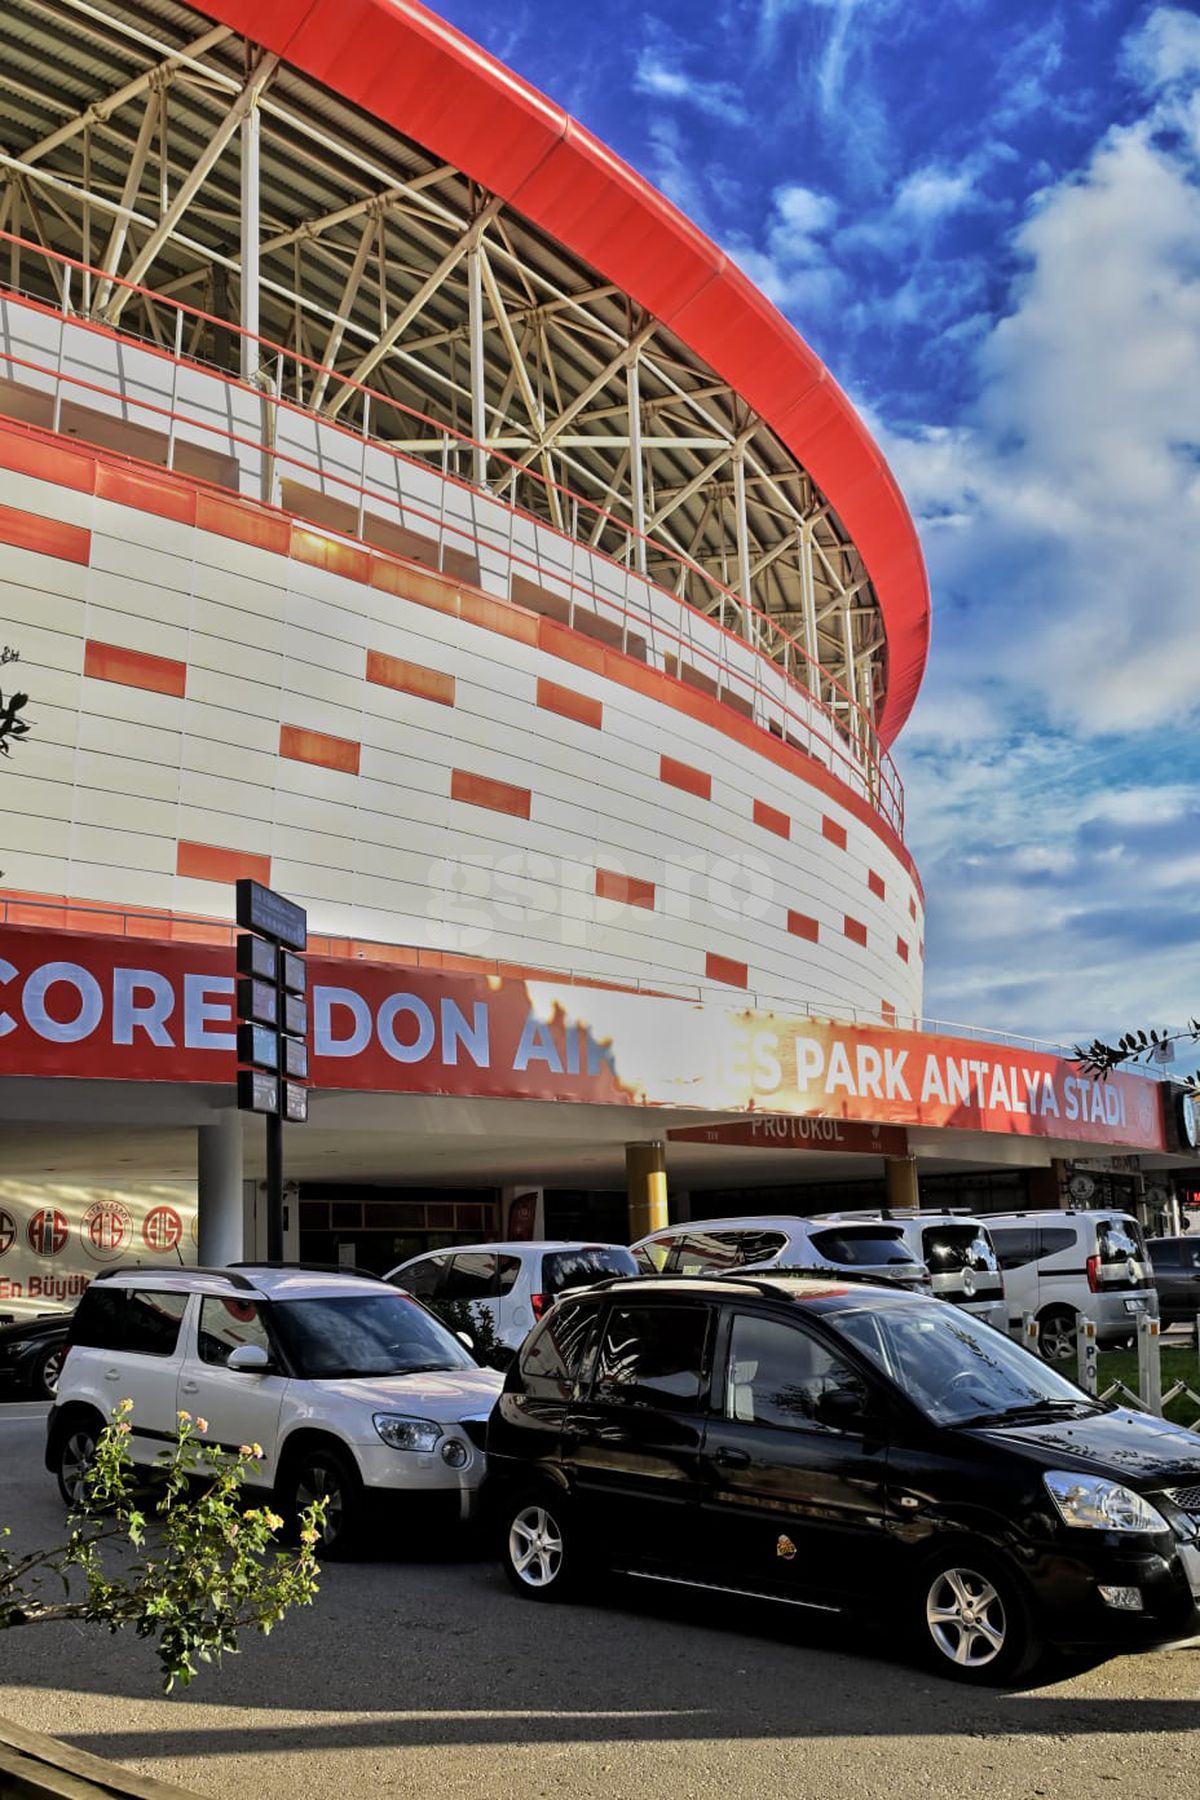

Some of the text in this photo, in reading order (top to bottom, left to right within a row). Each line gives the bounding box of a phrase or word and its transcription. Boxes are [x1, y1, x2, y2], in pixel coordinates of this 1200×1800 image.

[0, 957, 490, 1068] OREDON
[795, 1036, 913, 1102] PARK
[920, 1054, 1061, 1118] ANTALYA
[1064, 1075, 1126, 1128] STADI
[0, 1275, 90, 1301] En Büyük
